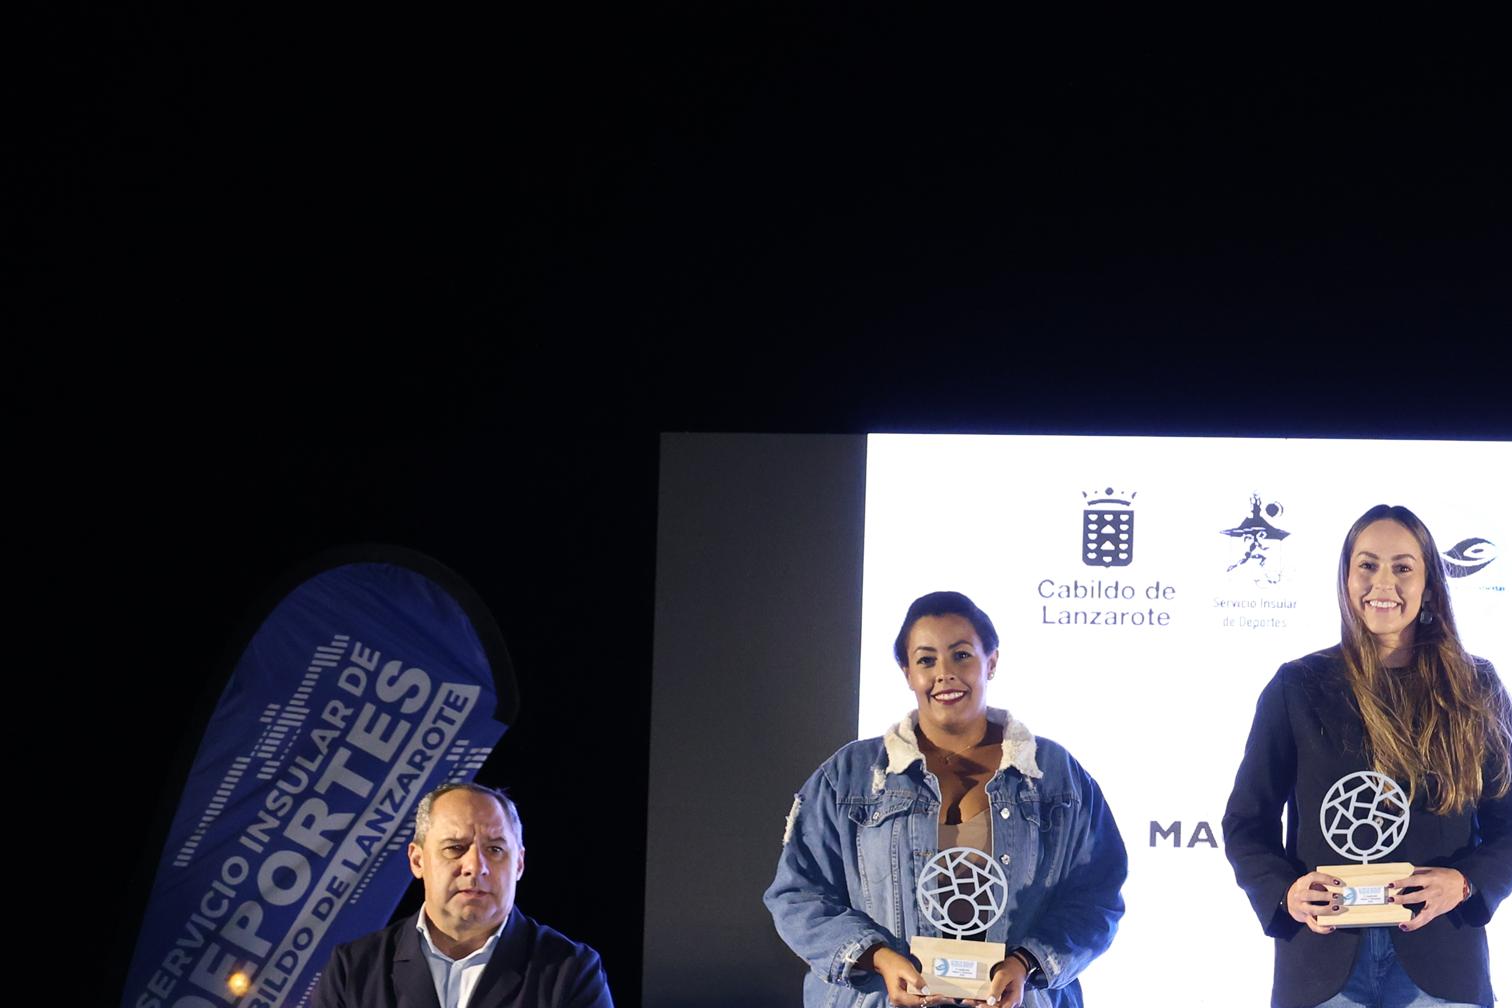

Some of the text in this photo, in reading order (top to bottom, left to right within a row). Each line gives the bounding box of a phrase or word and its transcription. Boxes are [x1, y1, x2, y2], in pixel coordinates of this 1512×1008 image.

[1037, 578, 1176, 601] Cabildo de
[1213, 597, 1298, 610] Servicio Insular
[1041, 605, 1171, 626] Lanzarote
[1222, 616, 1288, 630] de Deportes
[239, 699, 354, 854] INSULAR
[337, 641, 381, 697] DE
[312, 875, 351, 922] DE
[346, 688, 469, 875] LANZAROTE
